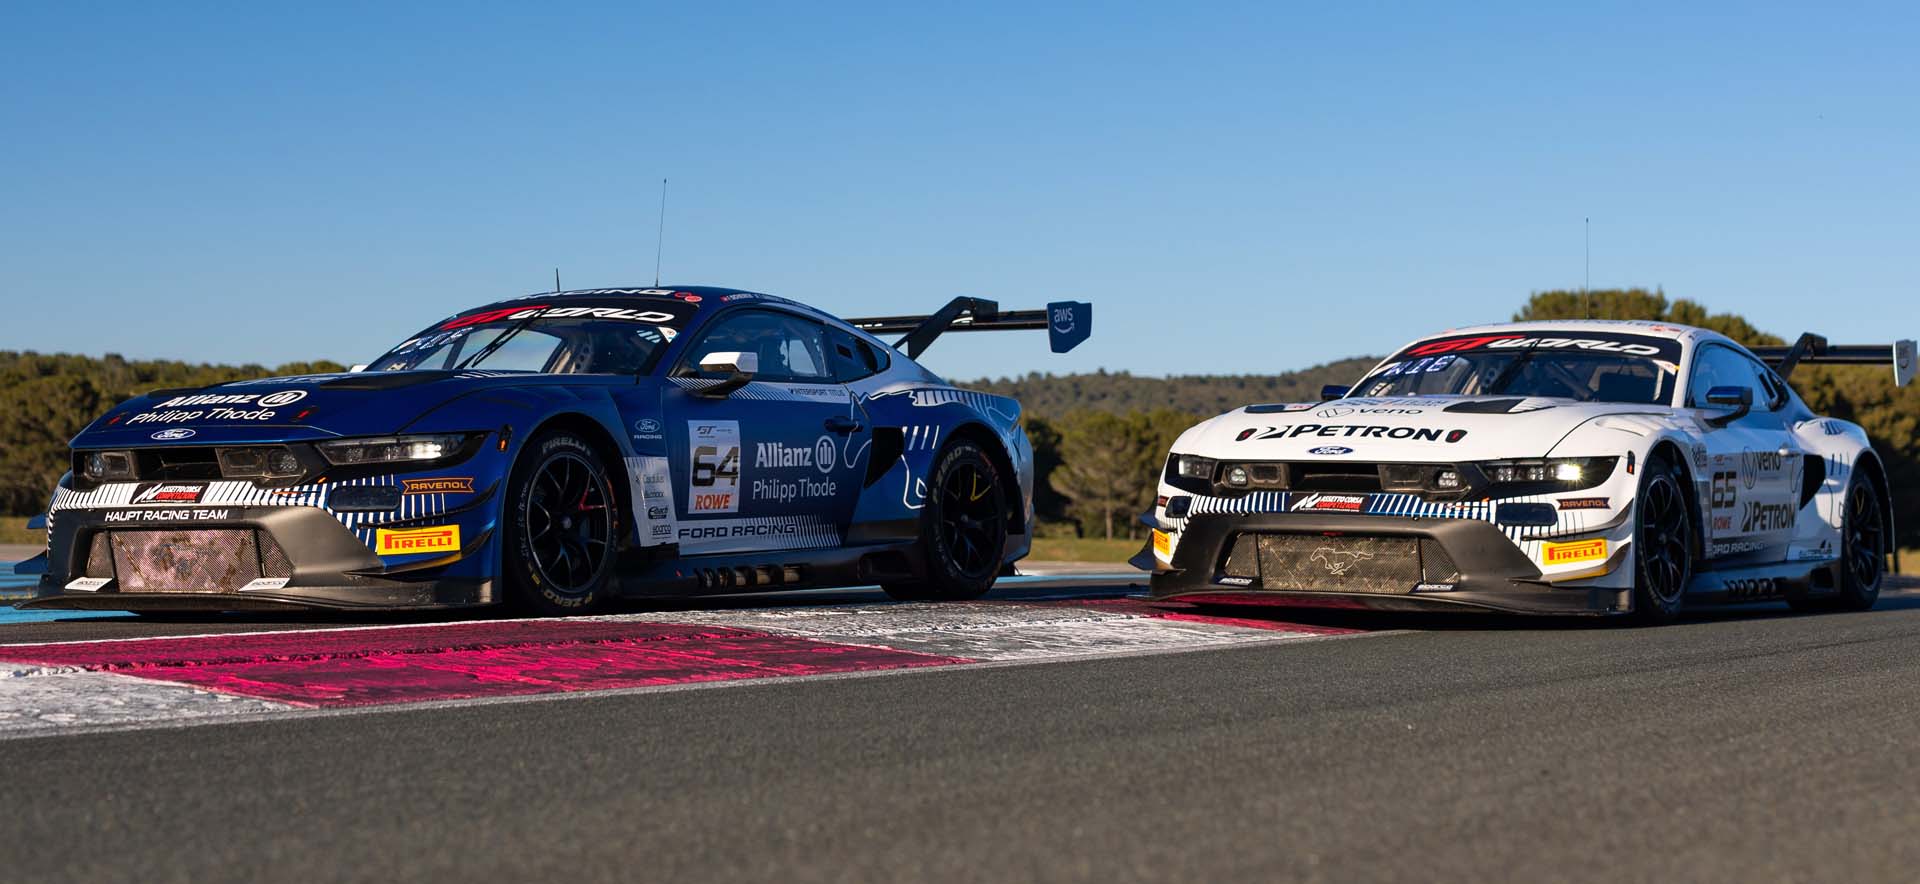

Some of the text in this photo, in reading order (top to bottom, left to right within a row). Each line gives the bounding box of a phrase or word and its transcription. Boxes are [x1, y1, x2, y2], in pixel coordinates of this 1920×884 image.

[508, 307, 674, 322] WORLD
[1054, 307, 1073, 323] aws
[1407, 335, 1660, 357] GT WORLD
[153, 393, 261, 409] Allianz
[126, 407, 276, 425] Philipp Thode
[1289, 424, 1444, 442] PETRON
[755, 442, 812, 468] Allianz
[1756, 452, 1780, 471] veno
[692, 445, 738, 487] 64
[410, 481, 467, 490] RAVENOL
[753, 477, 836, 502] Philipp Thode
[1712, 471, 1737, 508] 65
[695, 494, 731, 510] ROWE
[105, 509, 228, 522] HAUPT RACING TEAM
[1752, 501, 1796, 532] PETRON
[384, 530, 452, 549] PIRELLI
[679, 523, 797, 540] FORD RACING
[1548, 541, 1603, 561] PIRELLI
